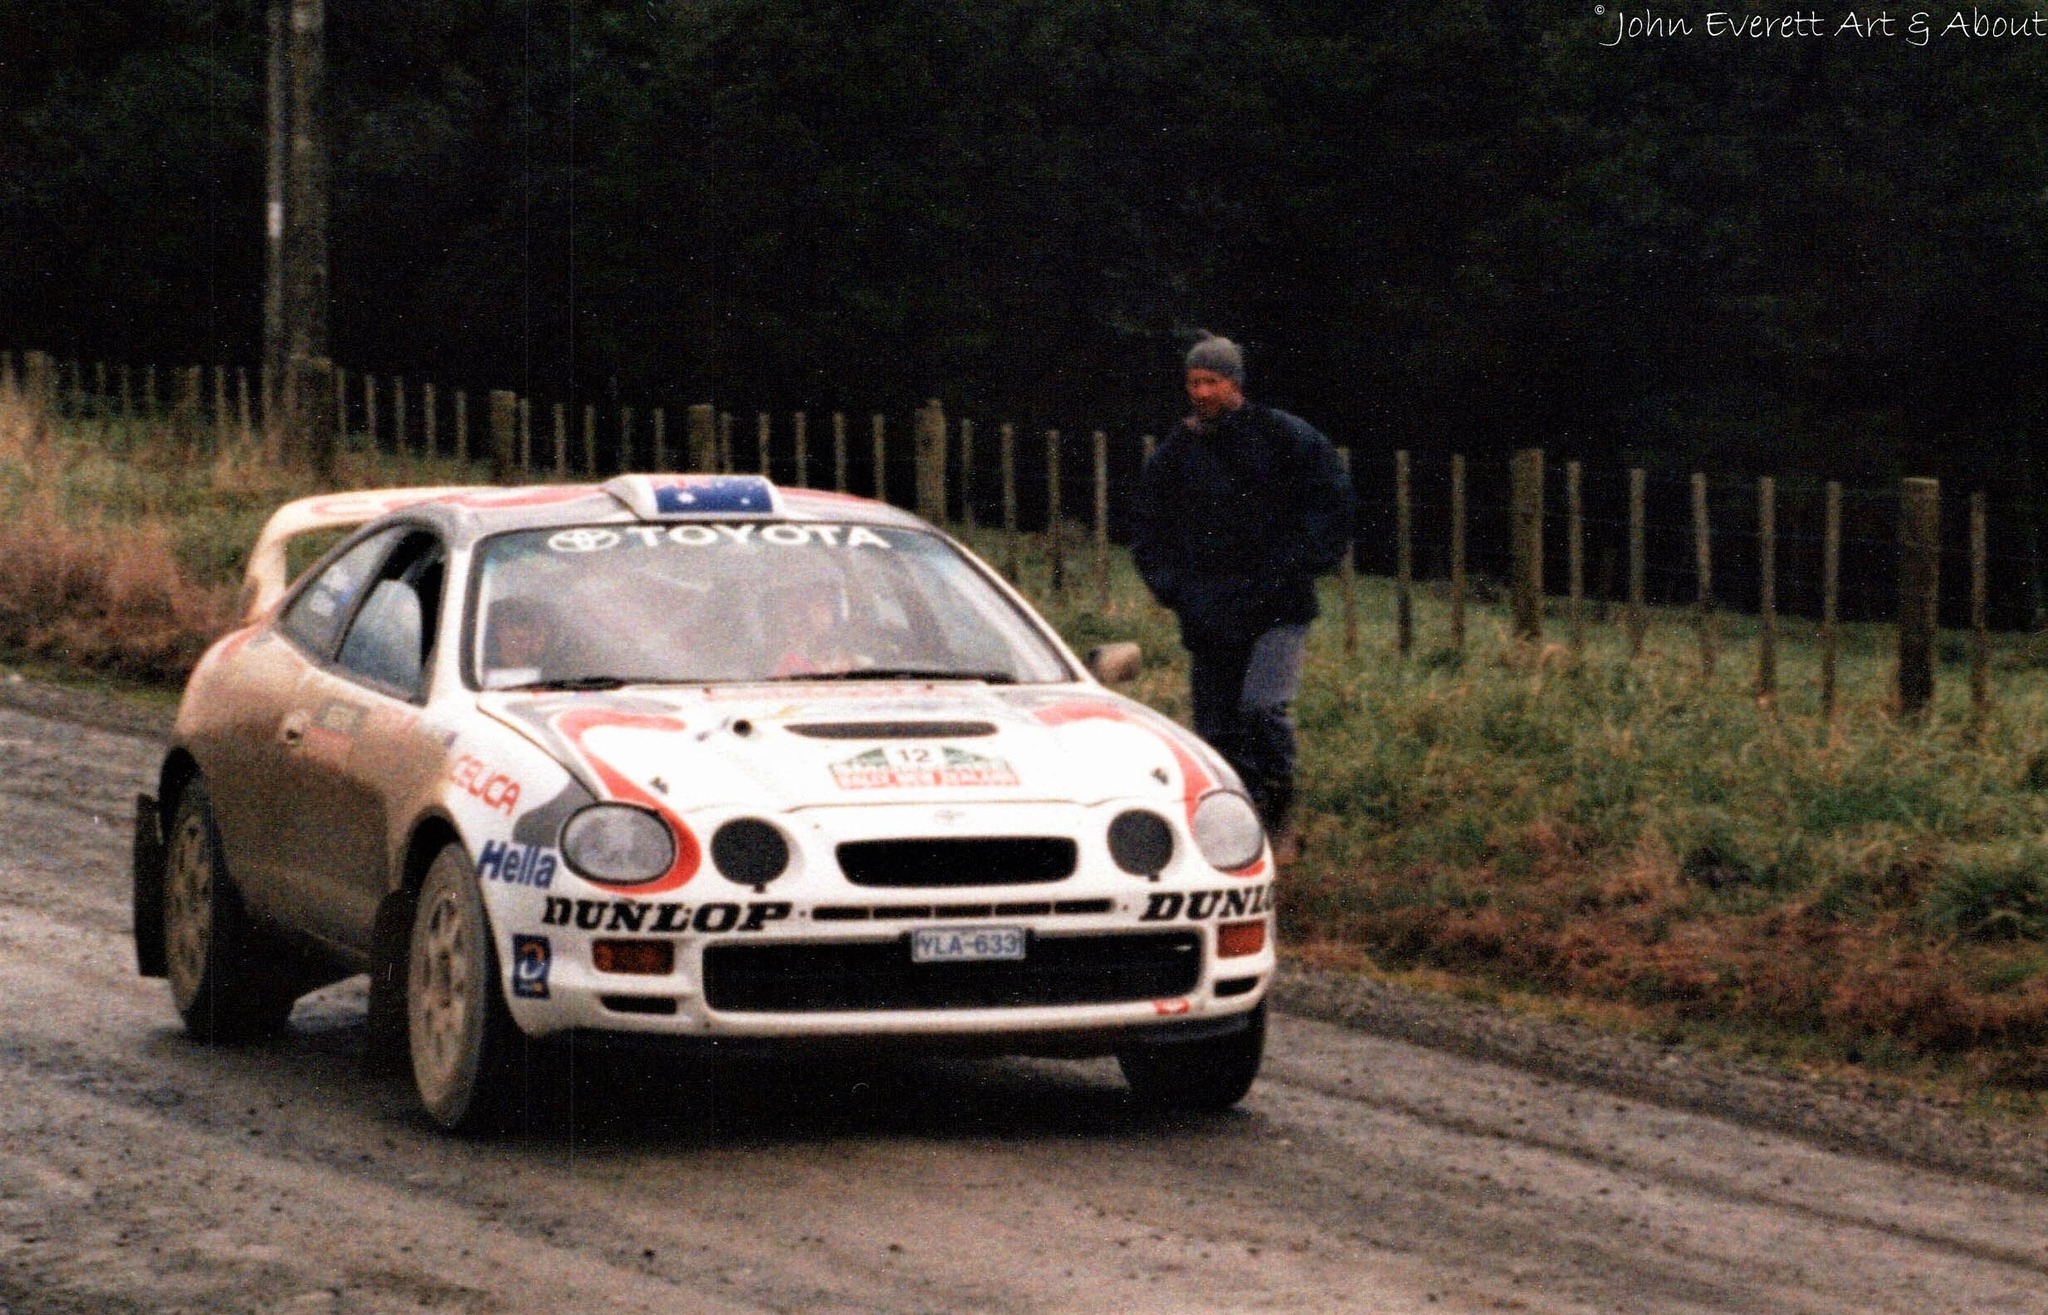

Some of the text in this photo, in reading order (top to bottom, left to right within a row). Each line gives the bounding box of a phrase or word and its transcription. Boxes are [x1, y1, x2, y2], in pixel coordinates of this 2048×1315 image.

[627, 524, 892, 549] TOYOTA
[897, 748, 930, 764] 12
[477, 840, 557, 888] Hella
[542, 896, 794, 934] DUNLOP
[918, 933, 1018, 958] YLA-633
